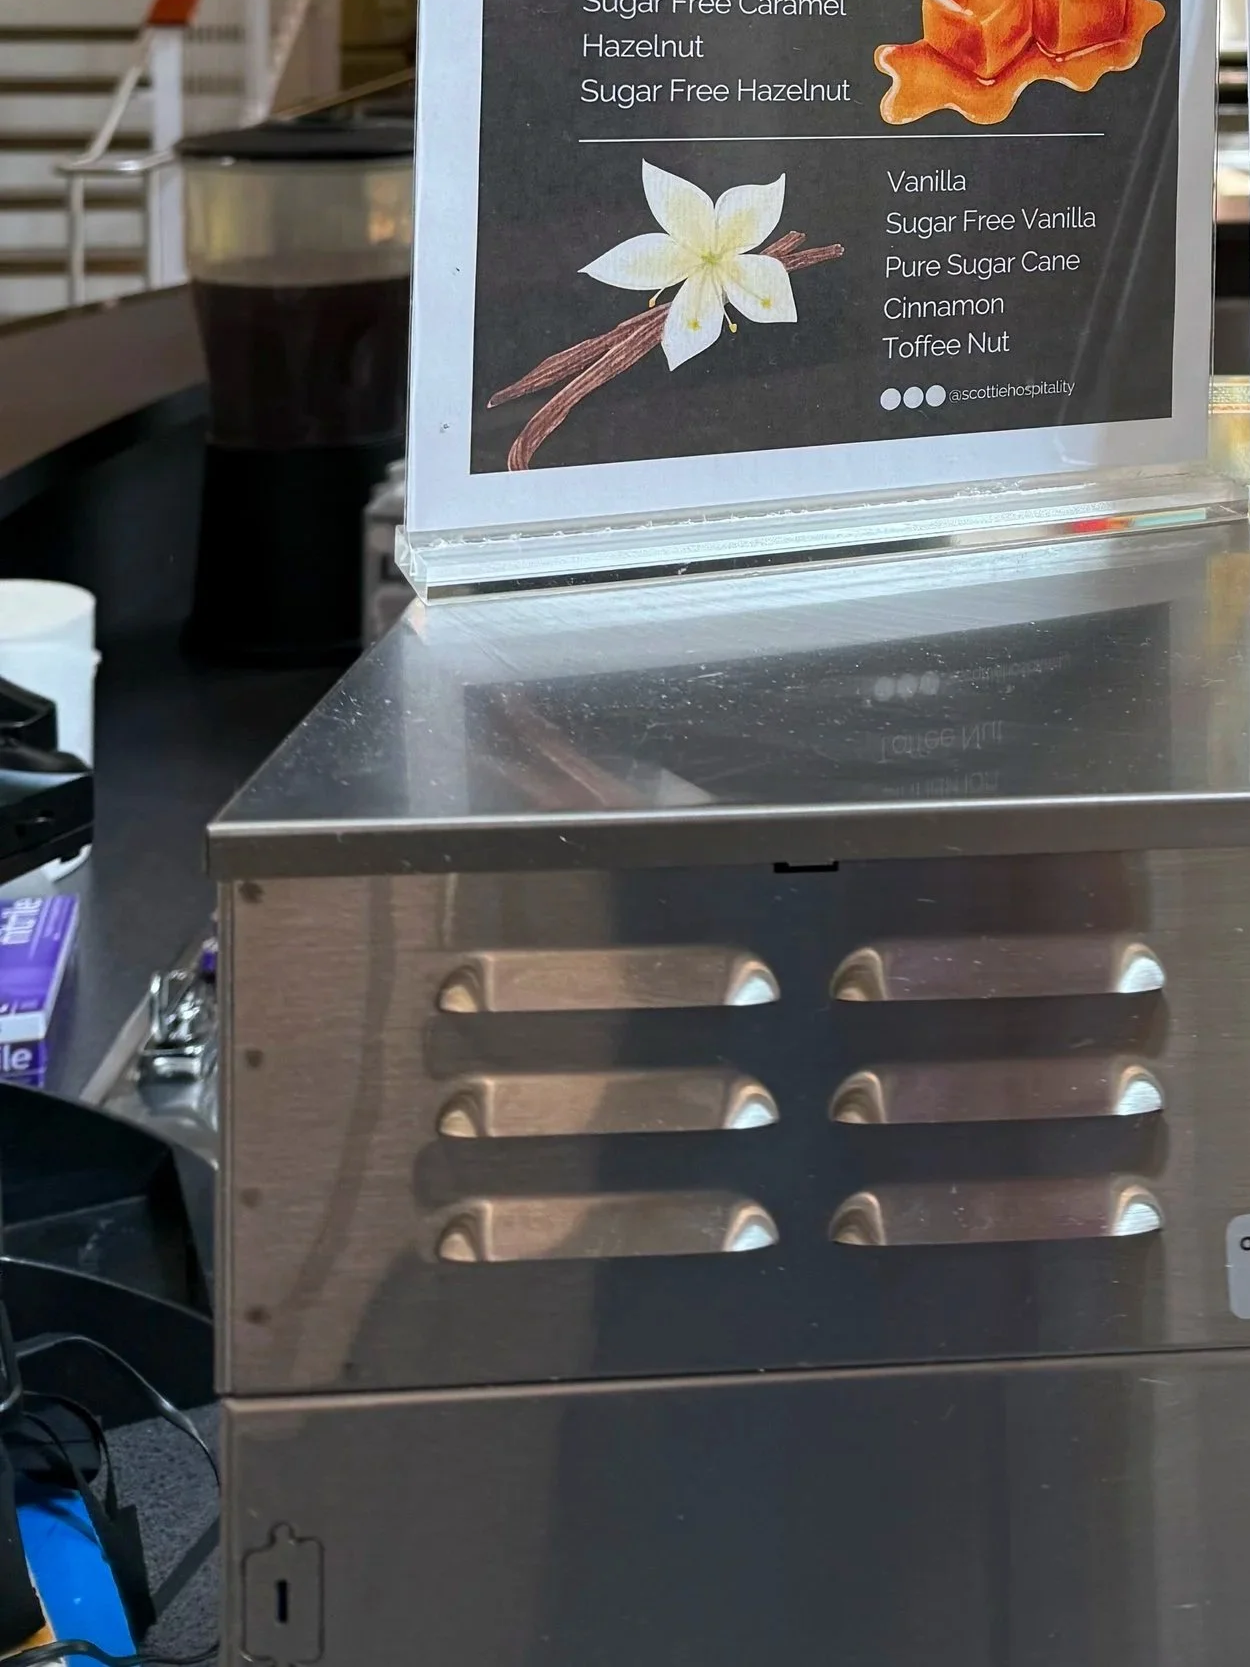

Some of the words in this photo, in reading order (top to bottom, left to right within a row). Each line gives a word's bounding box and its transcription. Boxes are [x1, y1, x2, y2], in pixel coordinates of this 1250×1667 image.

[583, 33, 705, 58] Hazelnut
[580, 78, 663, 109] Sugar
[670, 78, 730, 102] Free
[737, 78, 851, 102] Hazelnut
[886, 169, 967, 193] Vanilla
[885, 212, 957, 240] Sugar
[963, 209, 1016, 232] Free
[1021, 206, 1096, 230] Vanilla
[885, 256, 941, 279] Pure
[947, 253, 1016, 280] Sugar
[1021, 250, 1081, 272] Cane
[883, 297, 1004, 320] Cinnamon
[881, 334, 961, 359] Toffee
[968, 330, 1010, 355] Nut
[949, 380, 1076, 401] @scottiehospitality
